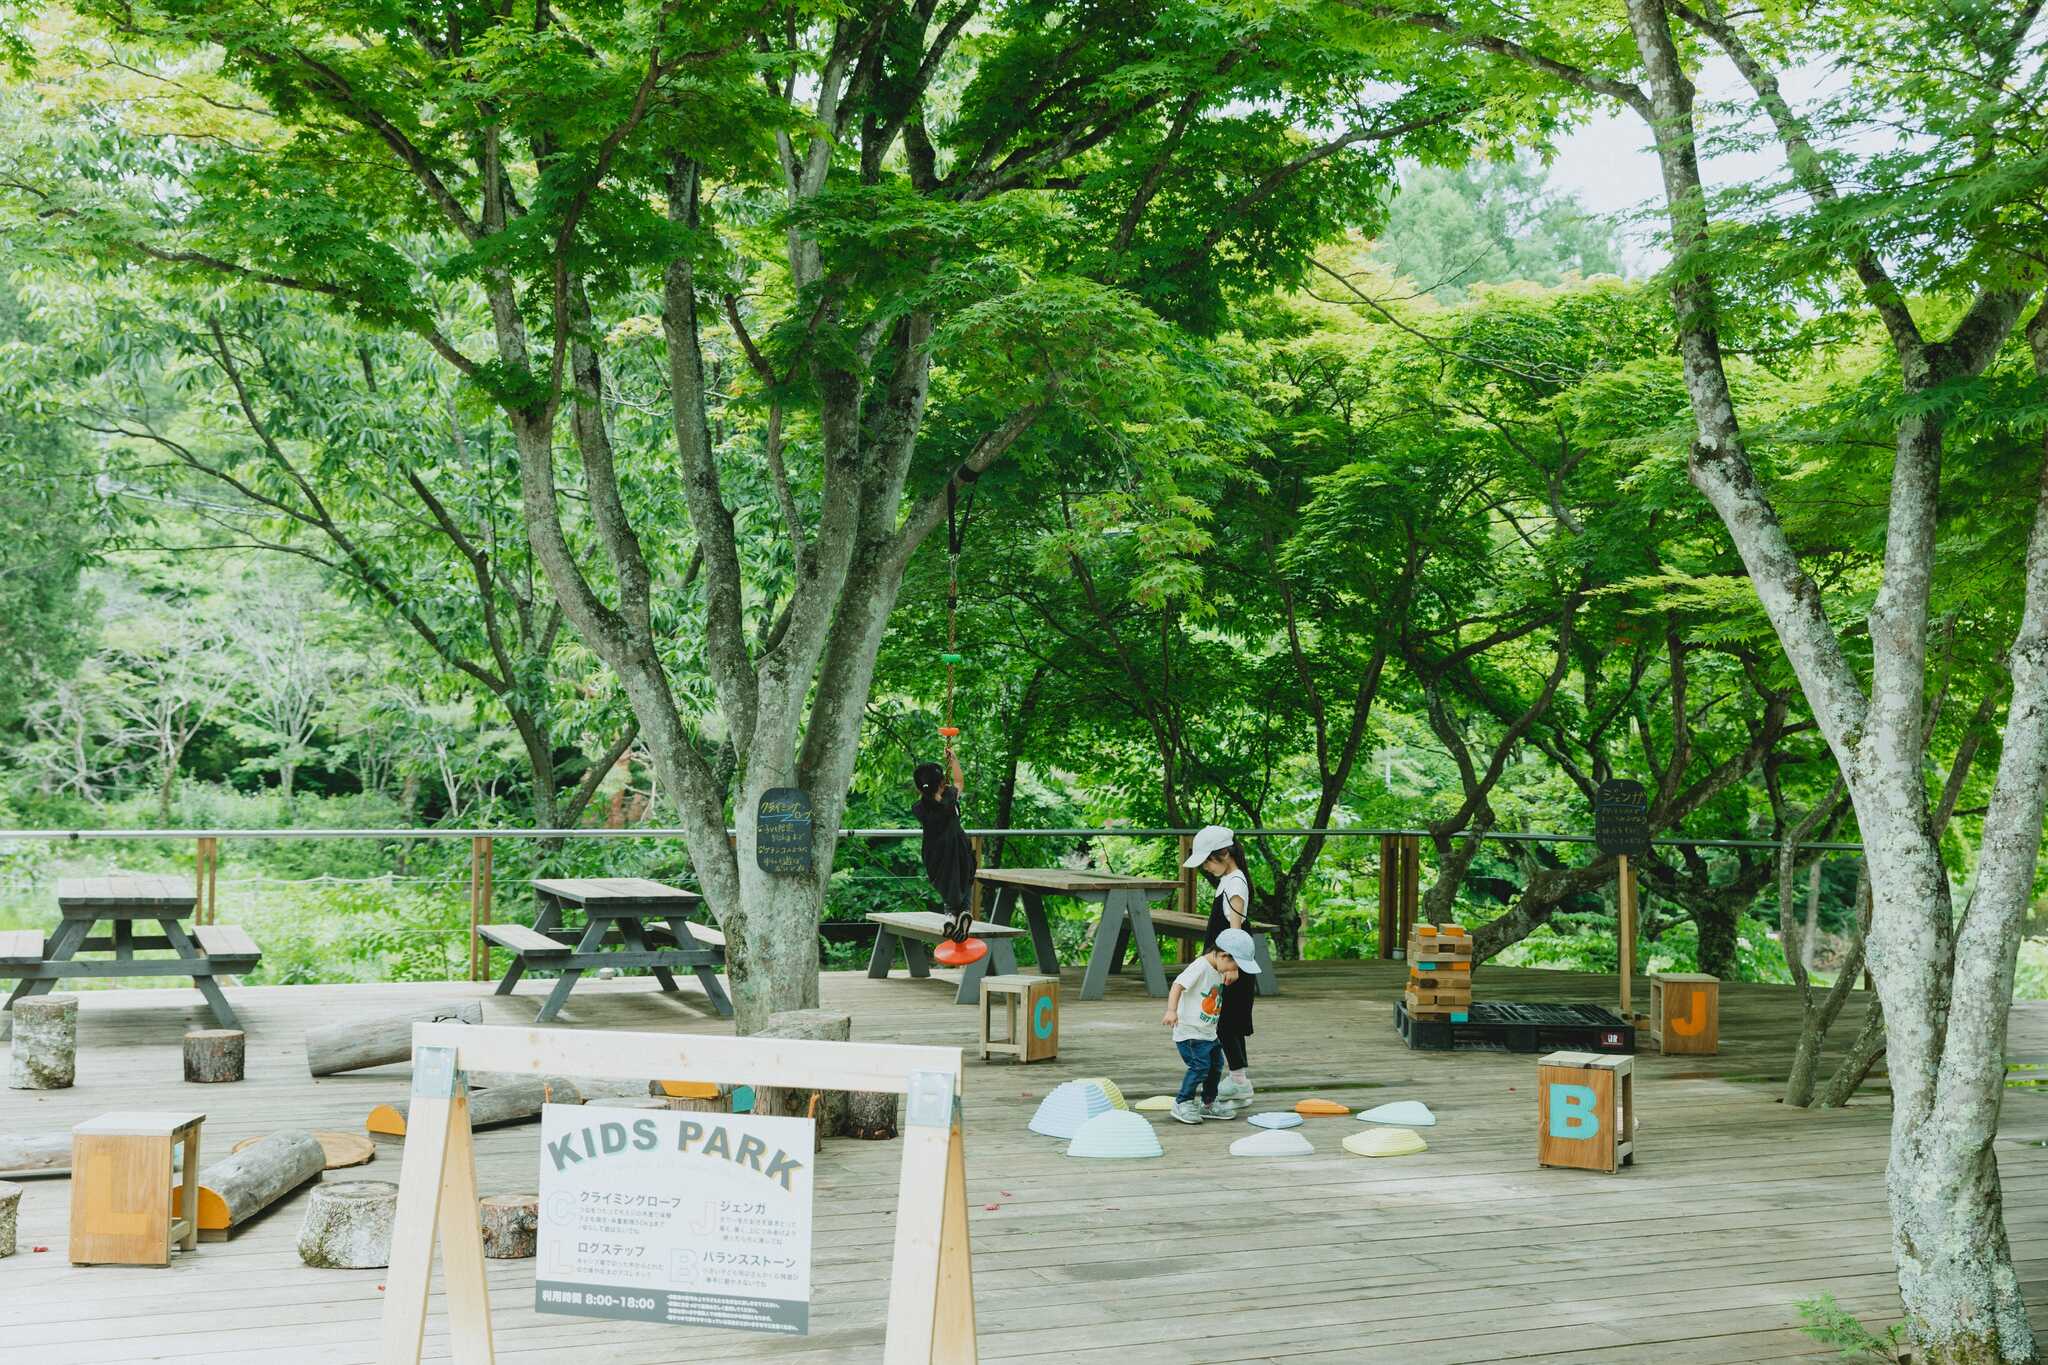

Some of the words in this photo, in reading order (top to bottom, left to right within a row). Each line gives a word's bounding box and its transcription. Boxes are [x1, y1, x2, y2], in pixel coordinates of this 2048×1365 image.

[1034, 995, 1054, 1040] C
[1672, 991, 1707, 1036] J
[1549, 1084, 1600, 1140] B
[547, 1118, 659, 1172] KIDS
[678, 1120, 804, 1193] PARK
[86, 1154, 149, 1236] L
[542, 1289, 582, 1305] 利用時間
